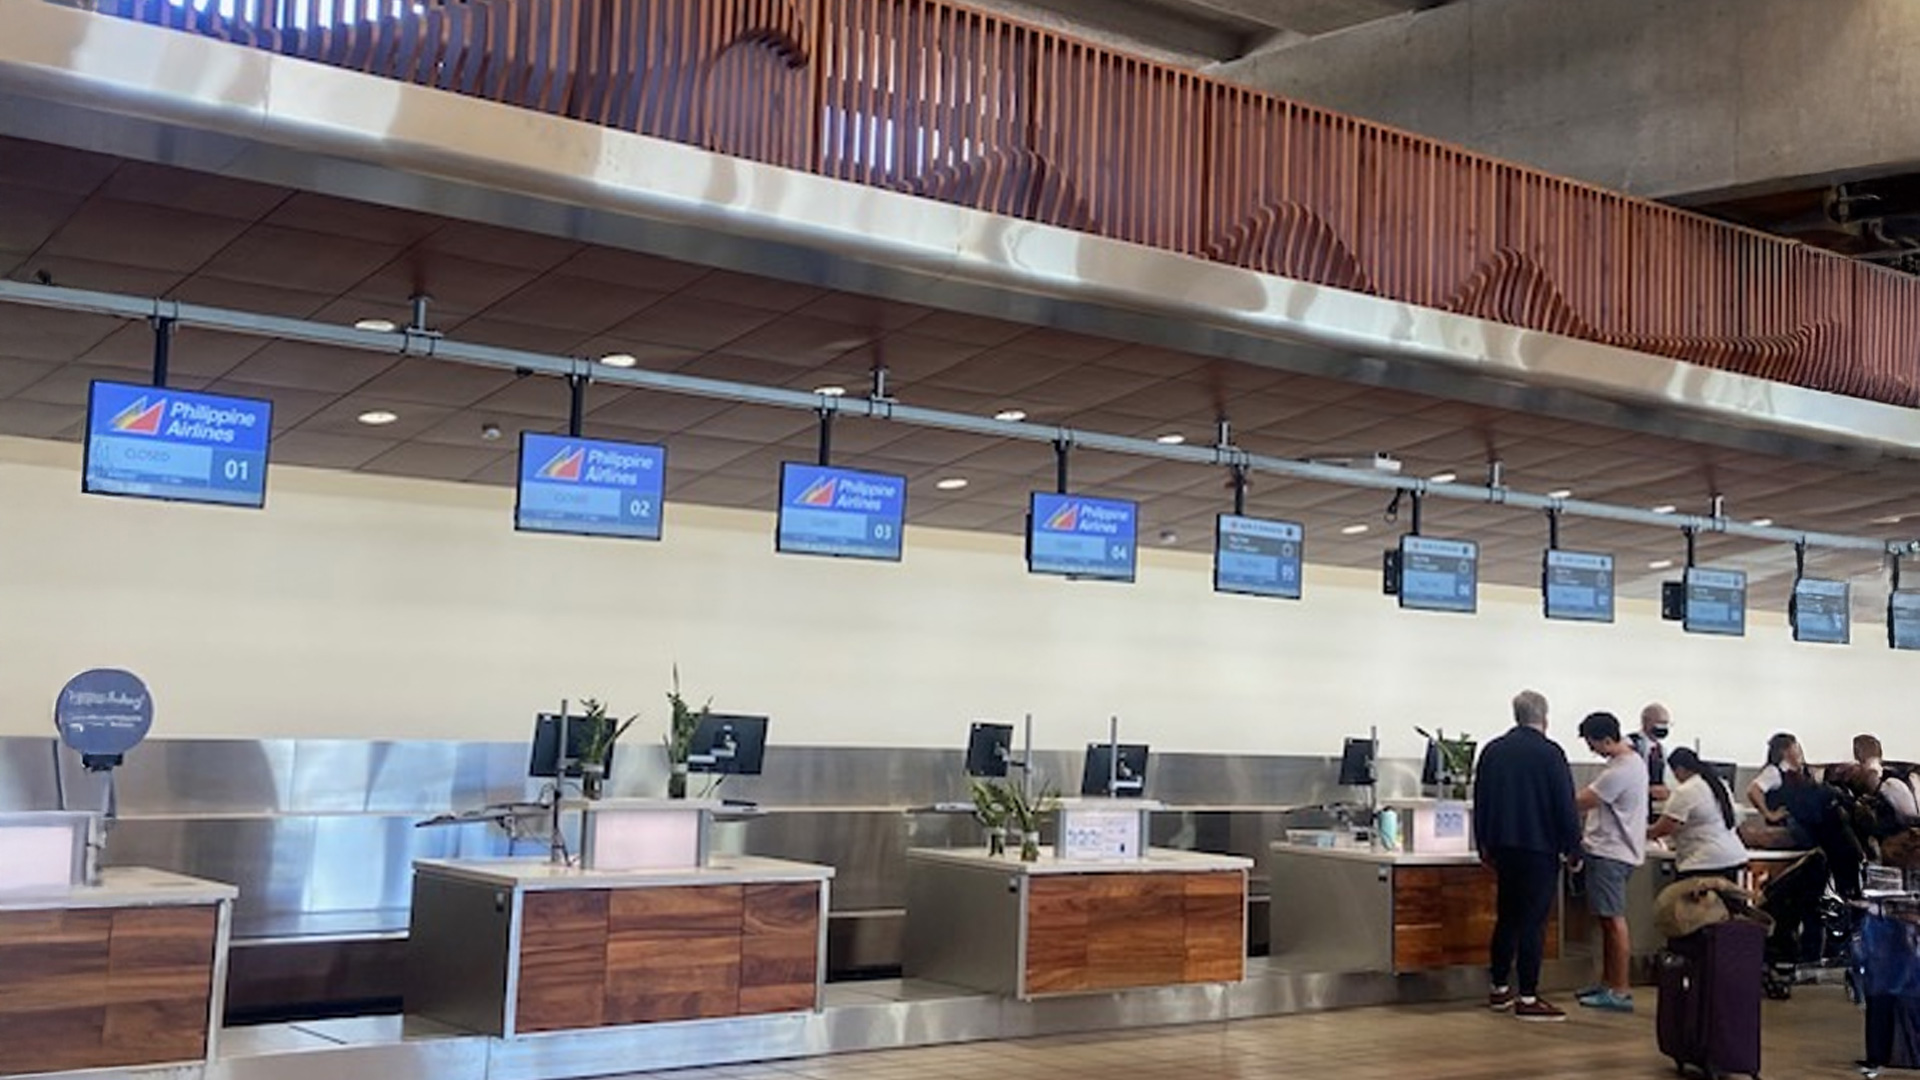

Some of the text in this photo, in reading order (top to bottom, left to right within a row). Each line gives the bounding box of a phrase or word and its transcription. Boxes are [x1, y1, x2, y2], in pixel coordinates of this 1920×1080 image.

[170, 401, 256, 427] Philippine
[165, 420, 235, 443] Airlines
[587, 450, 653, 469] Philippine
[224, 459, 249, 480] 01
[585, 466, 638, 486] Airlines
[838, 479, 897, 498] Philippine
[630, 500, 650, 517] 02
[836, 494, 882, 511] Airlines
[874, 524, 893, 540] 03
[1111, 545, 1128, 560] 04
